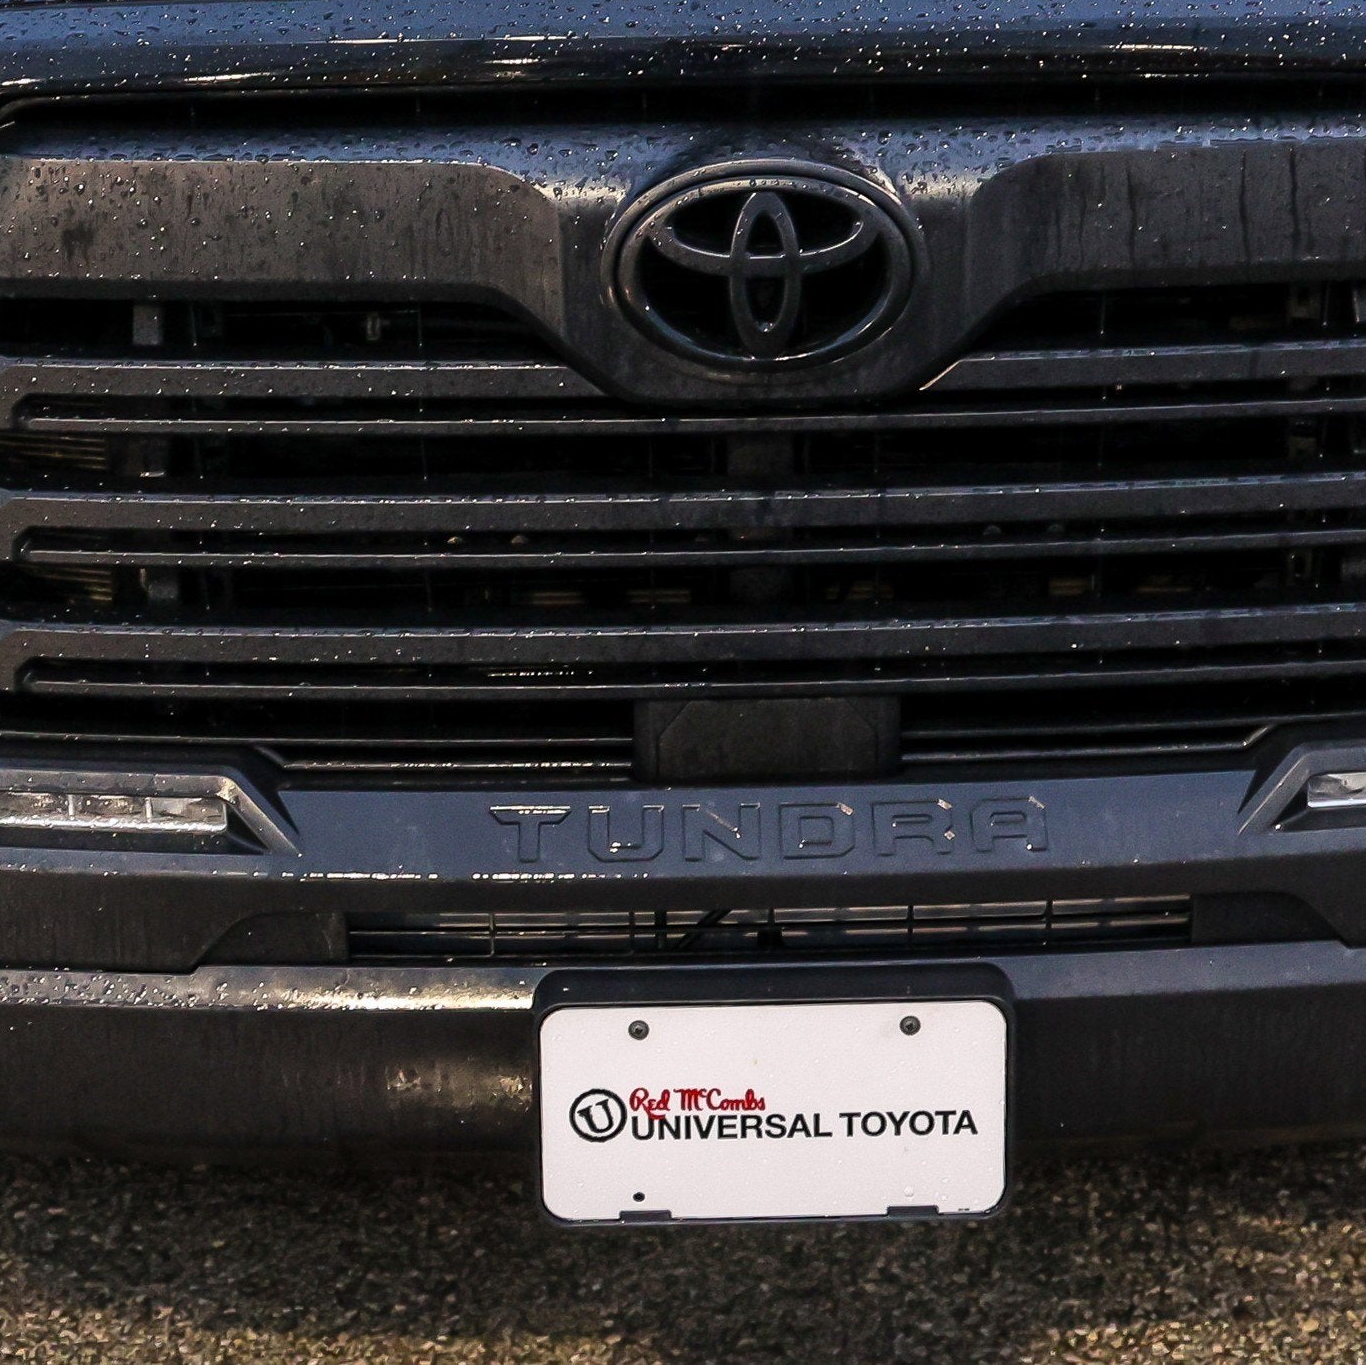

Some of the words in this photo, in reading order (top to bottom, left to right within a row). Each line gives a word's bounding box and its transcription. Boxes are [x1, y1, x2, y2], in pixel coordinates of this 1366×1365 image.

[489, 795, 1050, 864] TUNDRA
[629, 1087, 671, 1120] Red
[673, 1088, 766, 1111] McCombs
[631, 1112, 833, 1141] UNIVERSAL
[838, 1109, 979, 1137] TOYOTA
